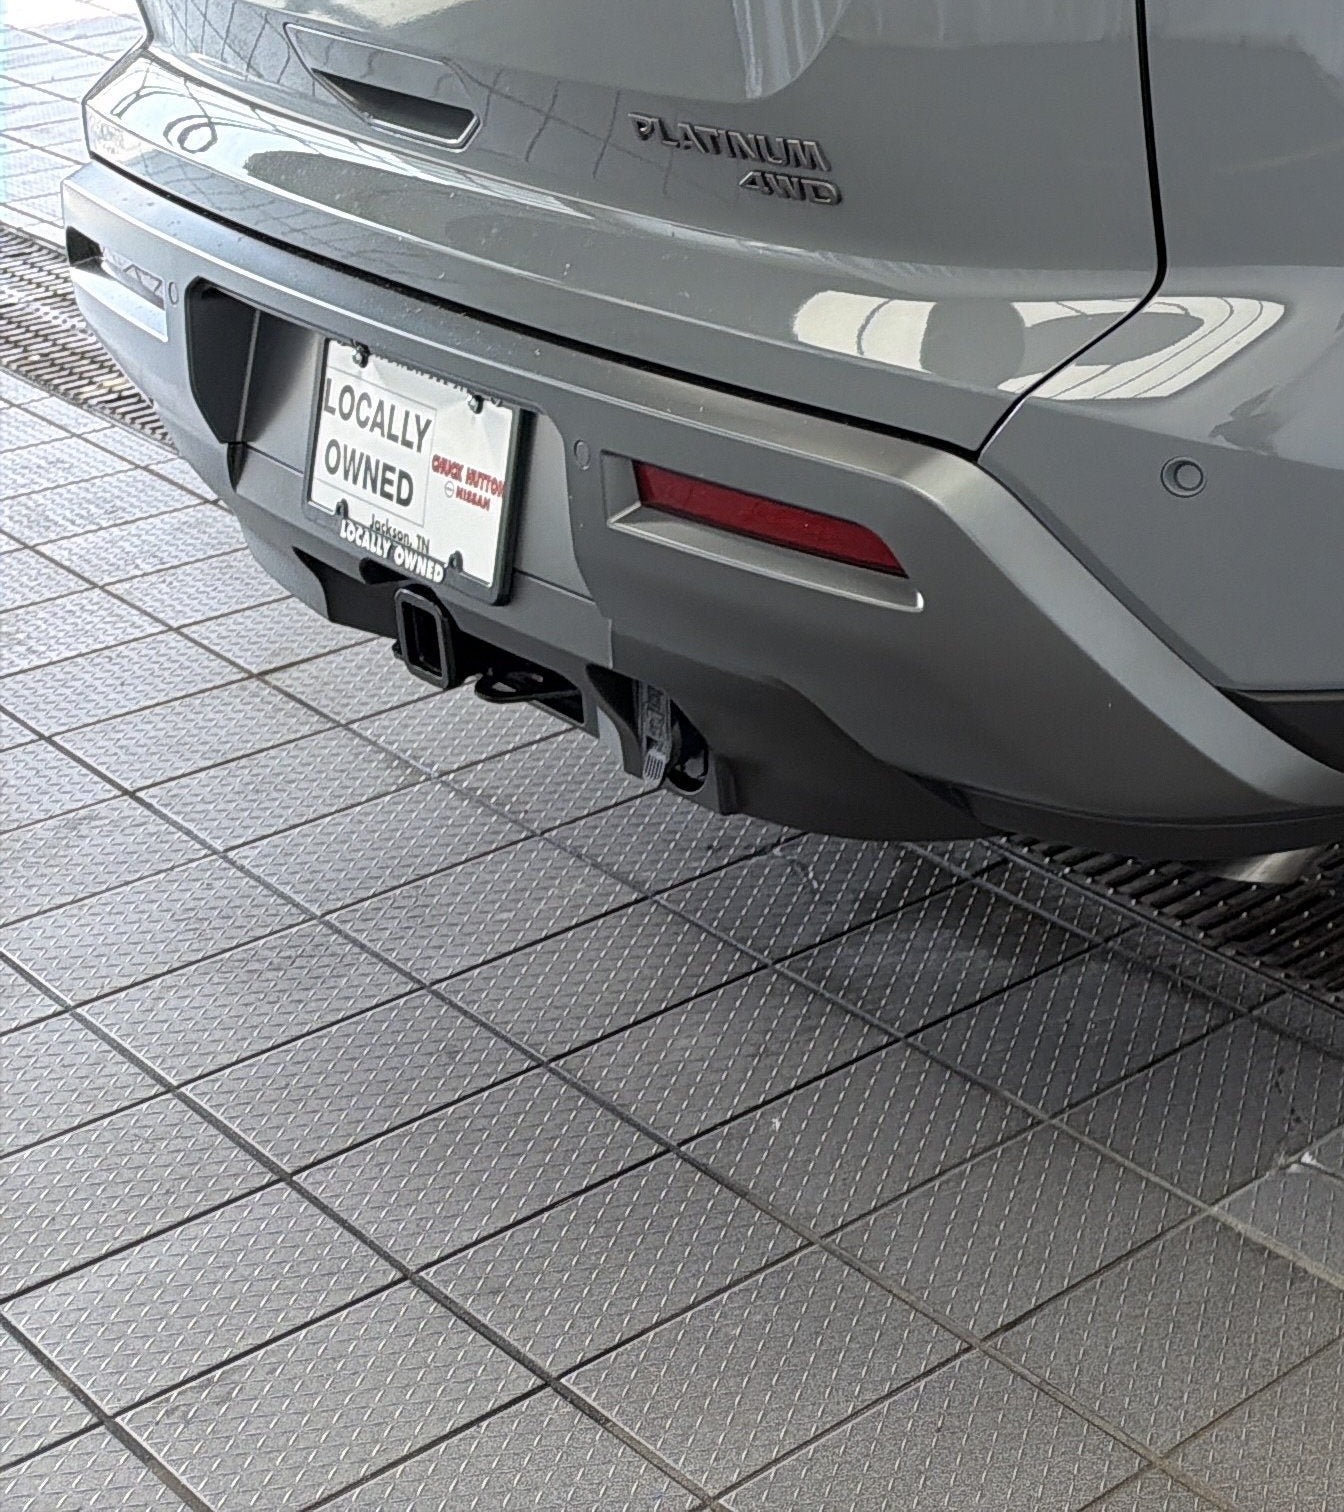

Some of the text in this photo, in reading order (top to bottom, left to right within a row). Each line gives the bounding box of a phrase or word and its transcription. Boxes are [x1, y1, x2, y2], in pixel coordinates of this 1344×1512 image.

[628, 112, 832, 172] PLATINUM
[739, 170, 843, 205] 4WD
[323, 377, 432, 454] LOCALLY
[324, 438, 414, 507] OWNED
[431, 454, 464, 483] CHUCK
[455, 485, 491, 512] NISSAN
[339, 518, 445, 583] LOCALLY OWNED
[416, 533, 430, 556] TN
